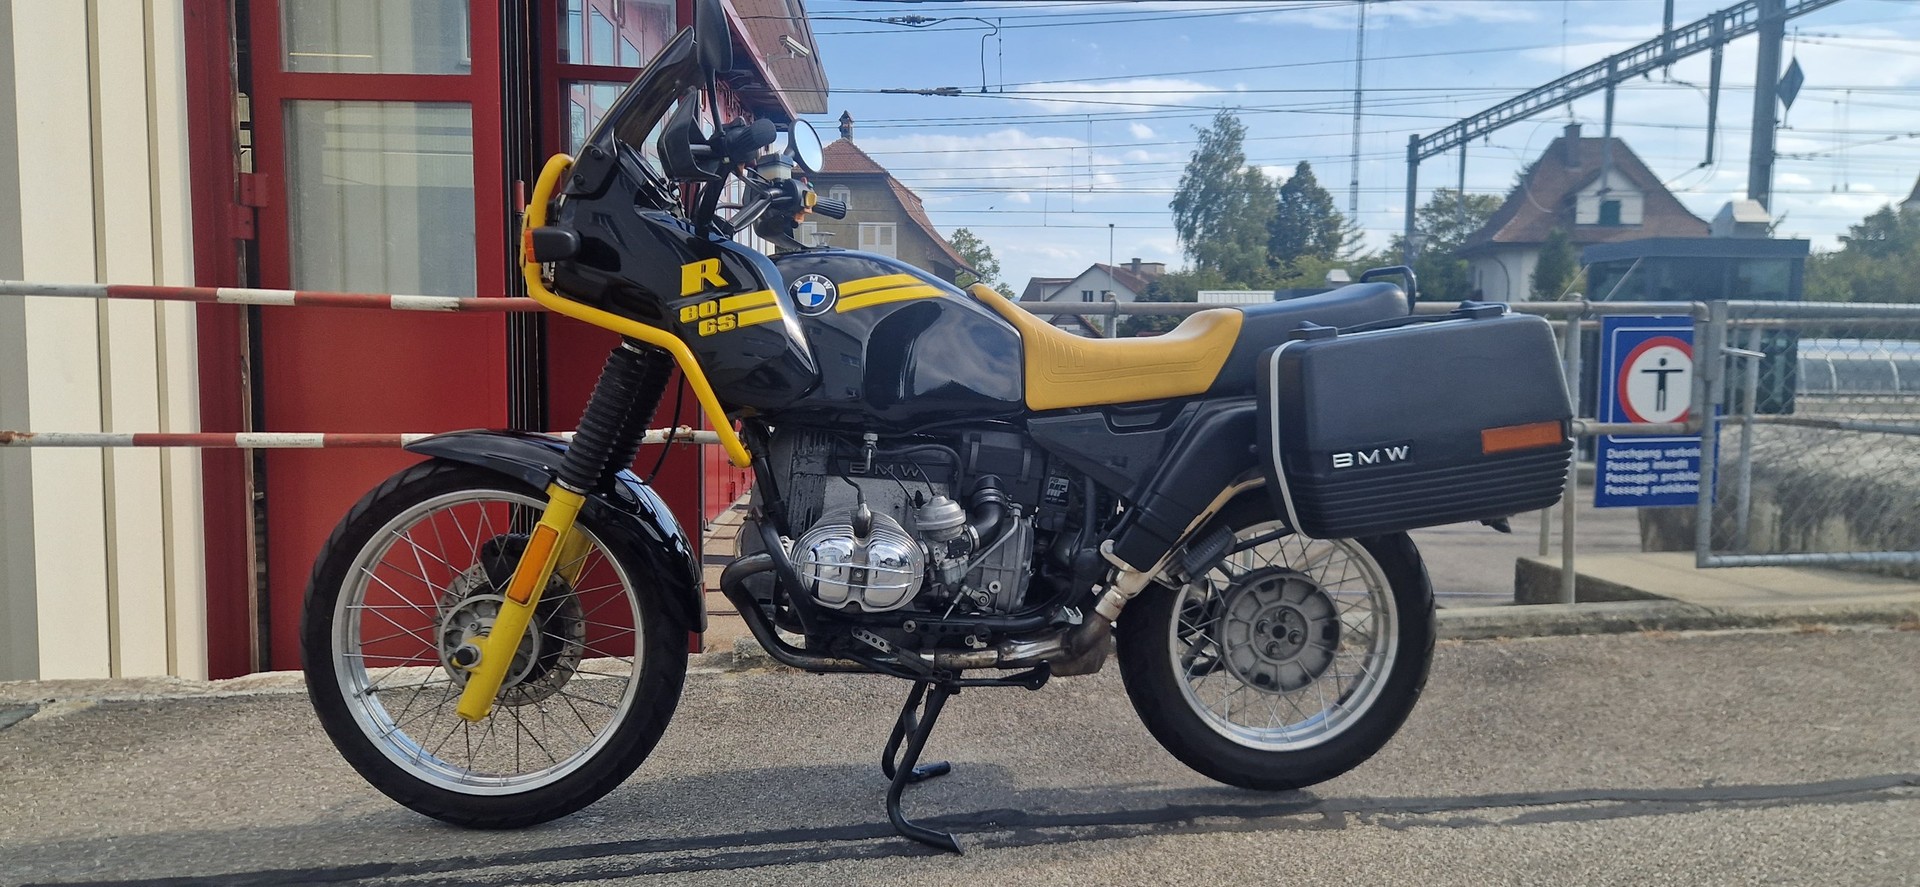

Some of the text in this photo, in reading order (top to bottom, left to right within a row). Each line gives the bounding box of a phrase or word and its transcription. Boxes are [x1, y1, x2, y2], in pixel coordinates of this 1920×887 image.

[680, 257, 729, 297] R
[794, 276, 833, 291] BMW
[680, 300, 718, 323] 80
[698, 313, 737, 337] GS
[1332, 444, 1410, 469] BMW
[1606, 447, 1701, 460] Durchgang verbote
[849, 462, 920, 478] BMW
[1605, 459, 1689, 472] Passage interdit
[1605, 472, 1659, 484] Passaggio
[1605, 484, 1649, 496] Passage
